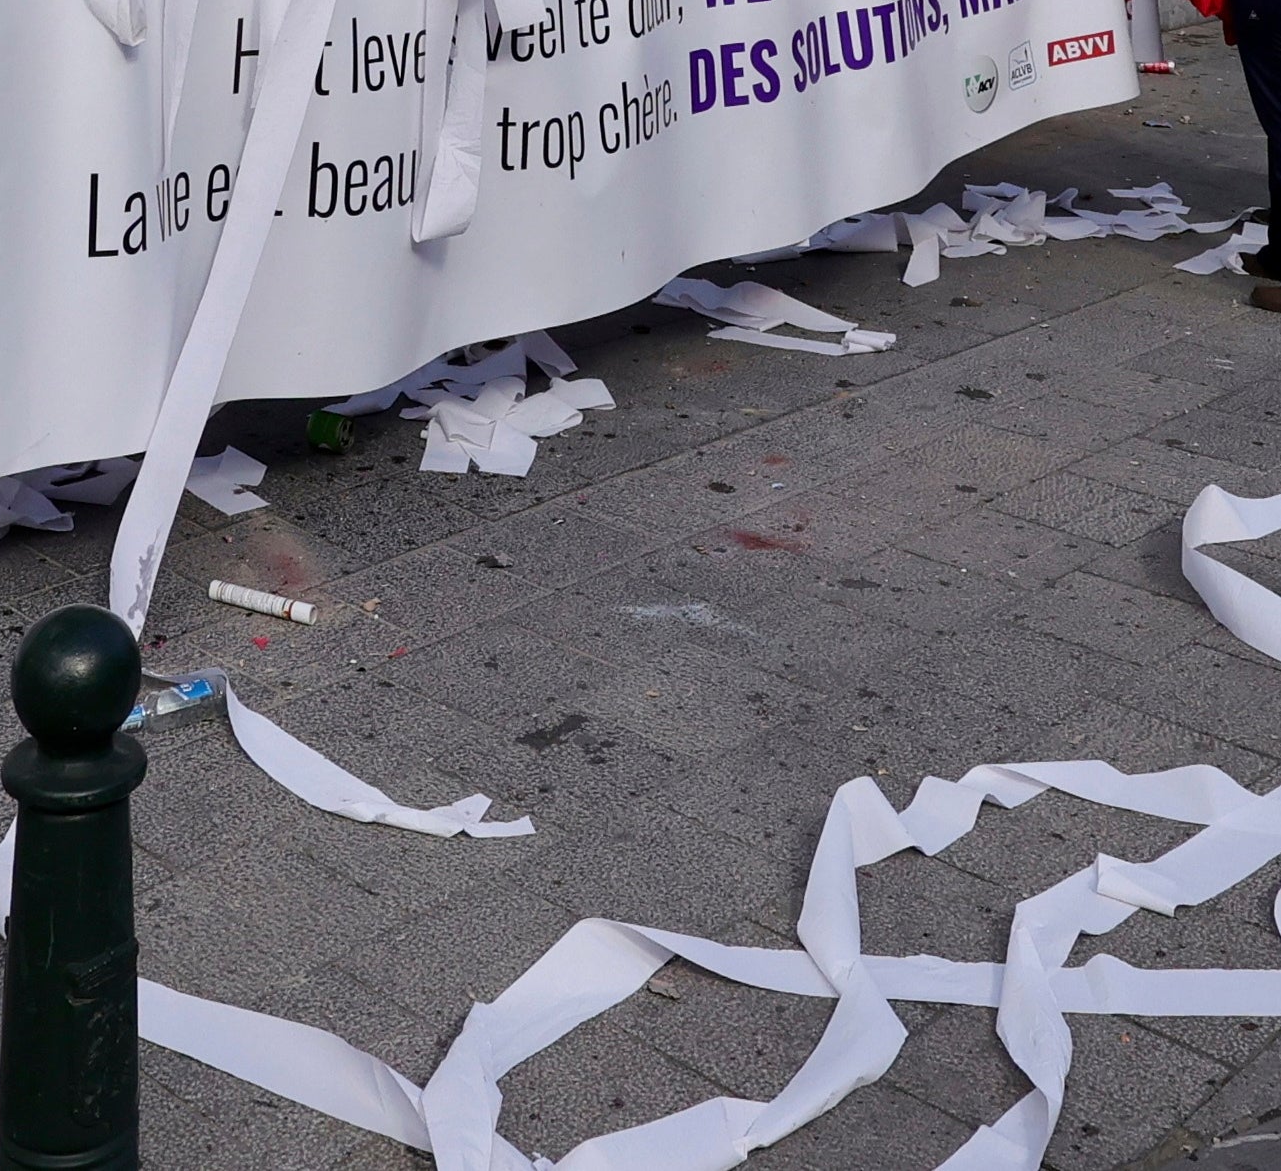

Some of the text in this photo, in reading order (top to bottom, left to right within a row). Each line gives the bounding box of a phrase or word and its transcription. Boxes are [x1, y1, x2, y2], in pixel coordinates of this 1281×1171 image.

[232, 17, 333, 96] Ht
[351, 16, 427, 94] leve
[1051, 34, 1110, 63] ABVV
[977, 76, 996, 95] ACV
[1011, 62, 1033, 81] ACLVB
[87, 172, 148, 258] La
[496, 106, 586, 180] trop
[599, 74, 678, 154] chère.
[689, 38, 782, 115] DES
